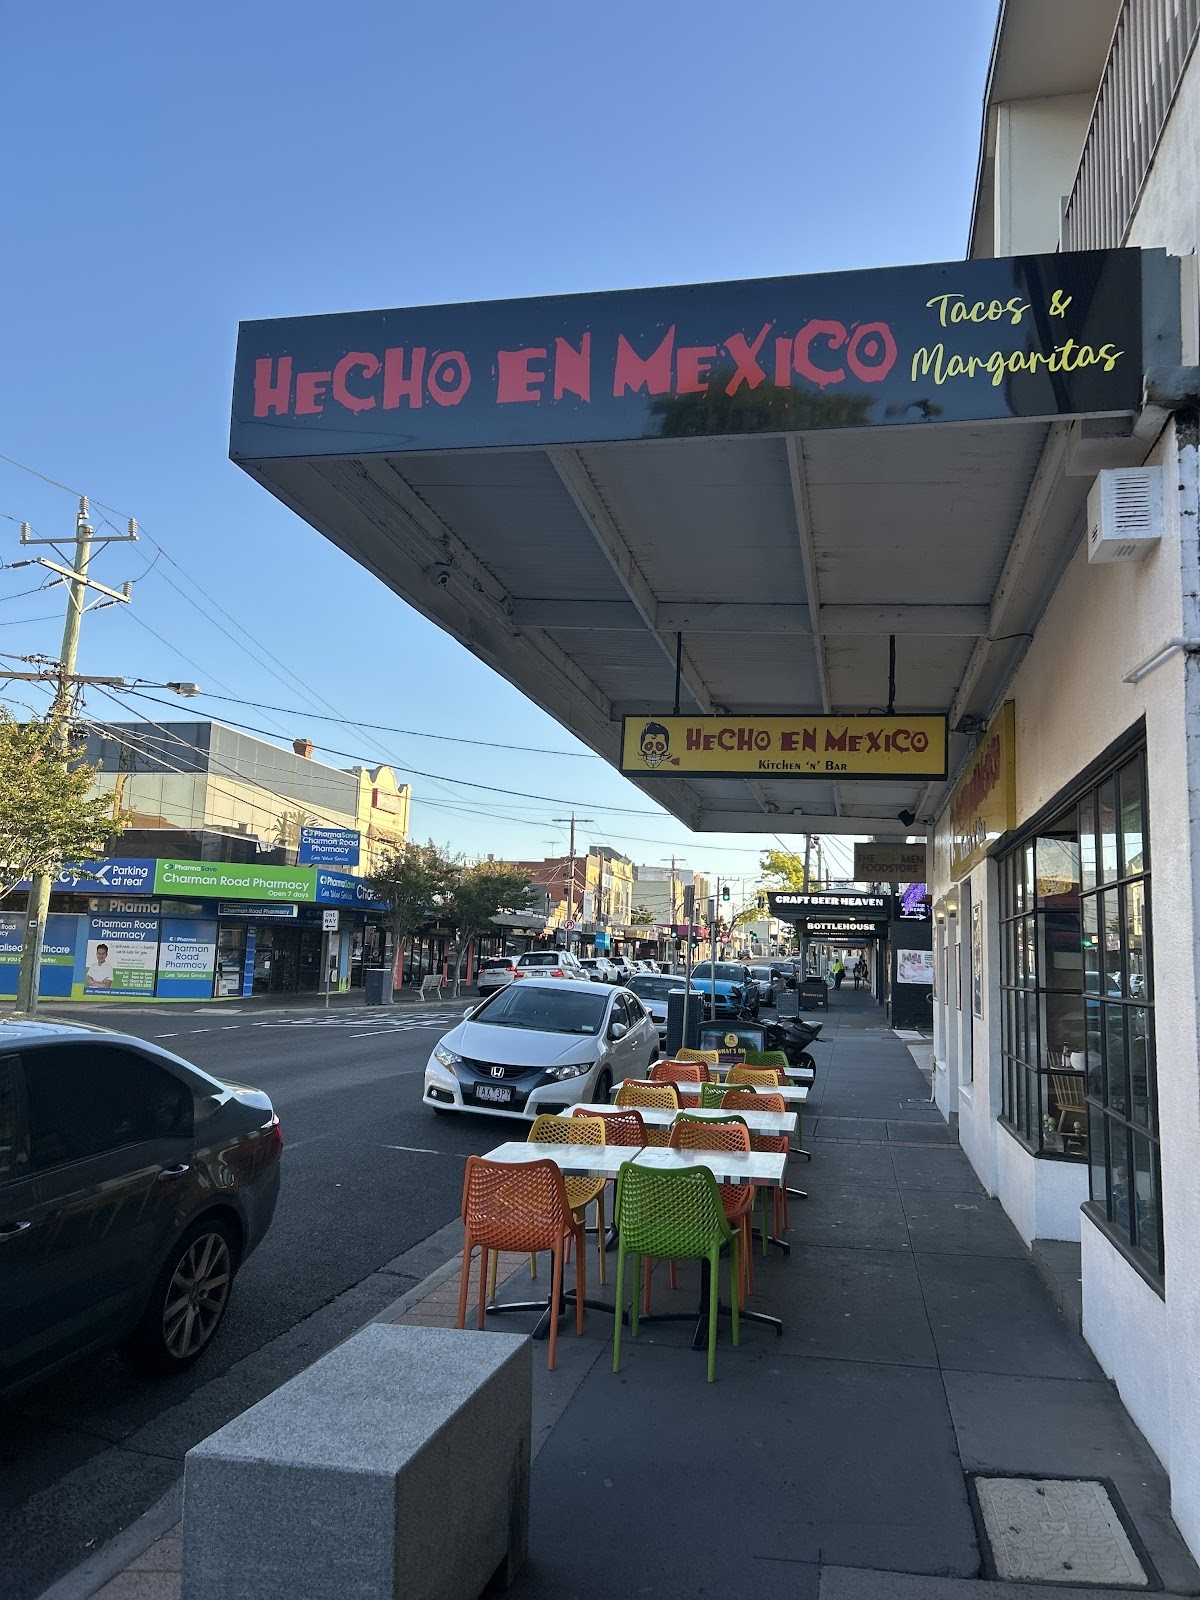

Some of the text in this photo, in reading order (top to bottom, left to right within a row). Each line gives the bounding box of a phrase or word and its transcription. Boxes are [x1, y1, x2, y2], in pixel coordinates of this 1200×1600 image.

[926, 289, 1073, 327] Tacos &
[911, 338, 1125, 387] Margaritas
[253, 318, 898, 418] HECHO EN MEXICO
[686, 727, 929, 754] HECHO EN MEXICO
[314, 830, 358, 839] PharmaSave
[302, 836, 359, 847] Charman Road
[311, 844, 350, 855] Pharmacy
[857, 854, 876, 863] THE
[901, 855, 924, 864] MEN
[112, 865, 148, 877] Parking
[174, 863, 218, 873] PharmaSave
[862, 863, 919, 873] FOODSTORE
[111, 877, 121, 886] at
[163, 872, 309, 892] Charman Road Pharmacy
[267, 890, 287, 898] Open
[294, 891, 309, 899] days
[775, 895, 884, 907] CRAFT BEER HEAVEN
[263, 908, 290, 916] Pharmacy
[92, 918, 157, 930] Charman Road
[807, 922, 876, 931] BOTTLEHOUSE
[101, 929, 146, 941] Pharmacy
[167, 943, 209, 953] Charman
[175, 952, 200, 961] Road
[165, 960, 208, 970] Pharmacy
